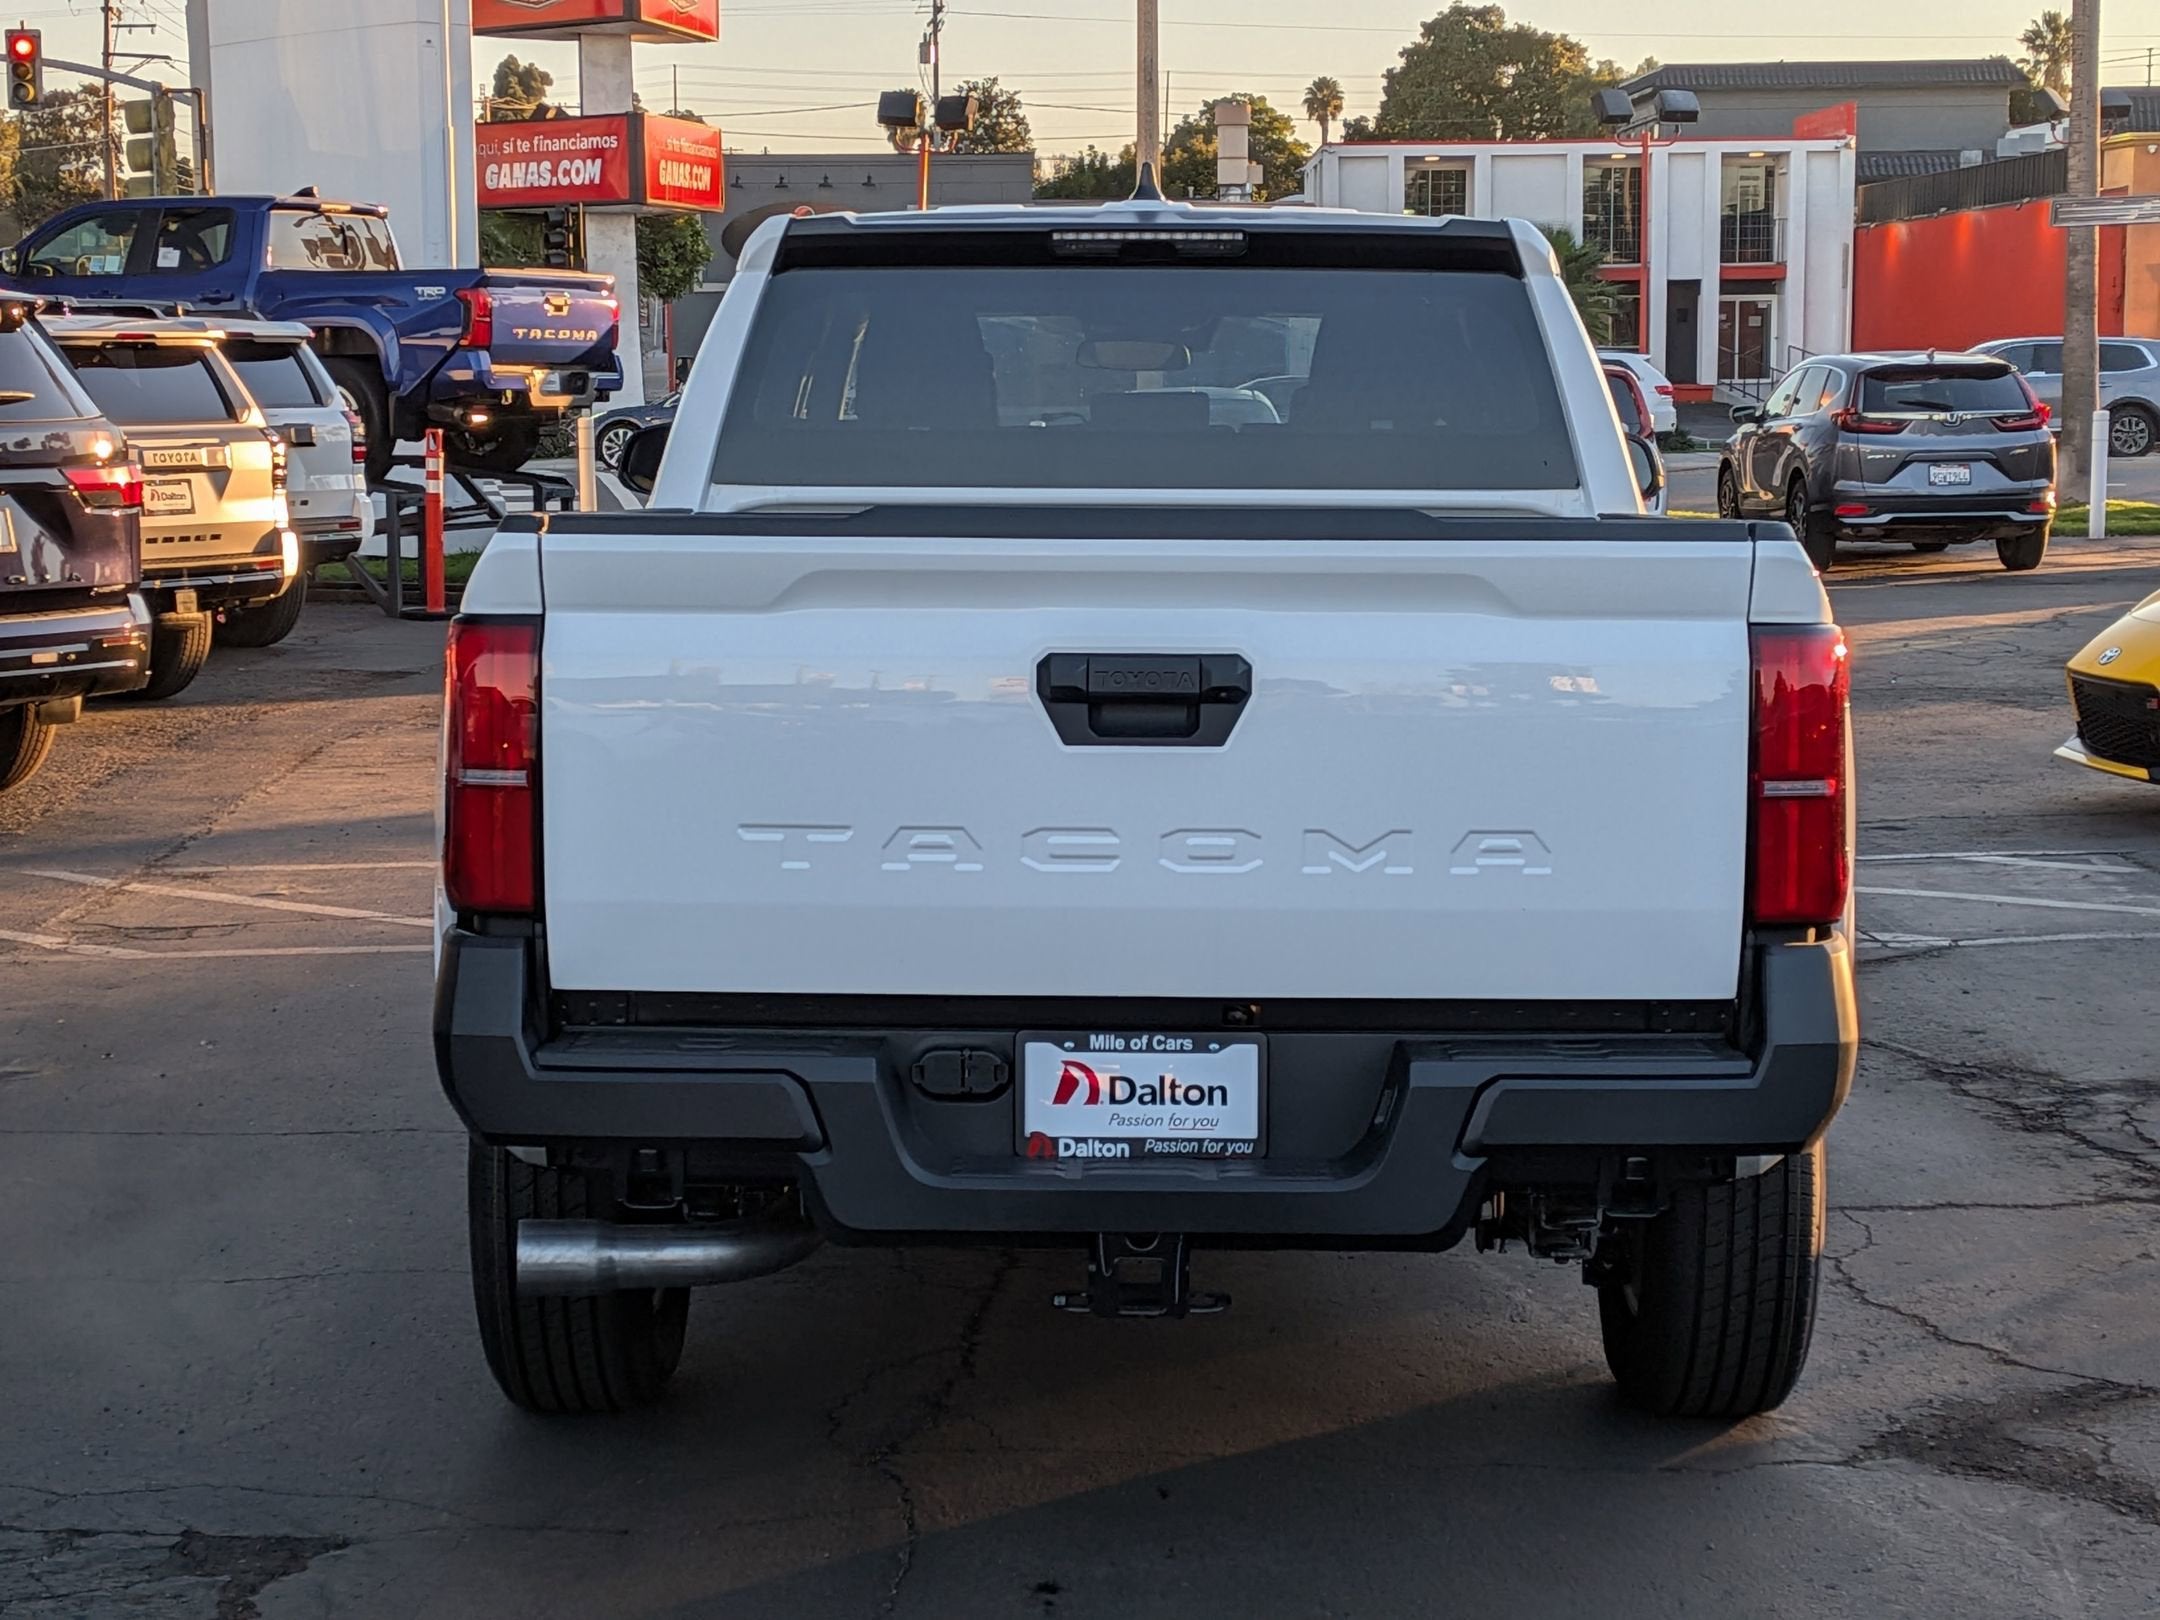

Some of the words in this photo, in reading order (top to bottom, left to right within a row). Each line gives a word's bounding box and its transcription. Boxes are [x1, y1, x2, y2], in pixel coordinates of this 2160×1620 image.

[477, 139, 501, 158] quí,
[503, 136, 515, 154] sí
[517, 138, 531, 154] te
[533, 132, 618, 152] financiamos
[485, 157, 603, 190] GANAS.COM
[659, 159, 712, 192] GANAS.COM
[414, 286, 446, 297] TRD
[512, 327, 599, 341] TACOMA
[152, 452, 197, 464] TOYOTA
[161, 491, 187, 501] Dalton
[1095, 670, 1194, 688] TOYOTA
[737, 823, 1553, 875] TACOMA
[1089, 1034, 1125, 1051] Mile
[1129, 1034, 1149, 1051] of
[1152, 1035, 1193, 1051] Cars
[1108, 1074, 1228, 1106] Dalton
[1108, 1113, 1164, 1128] Passion
[1167, 1112, 1189, 1128] for
[1191, 1115, 1219, 1129] you
[1058, 1138, 1130, 1158] Dalton
[1144, 1138, 1199, 1154] Passion
[1201, 1139, 1223, 1155] for
[1225, 1141, 1254, 1157] you
